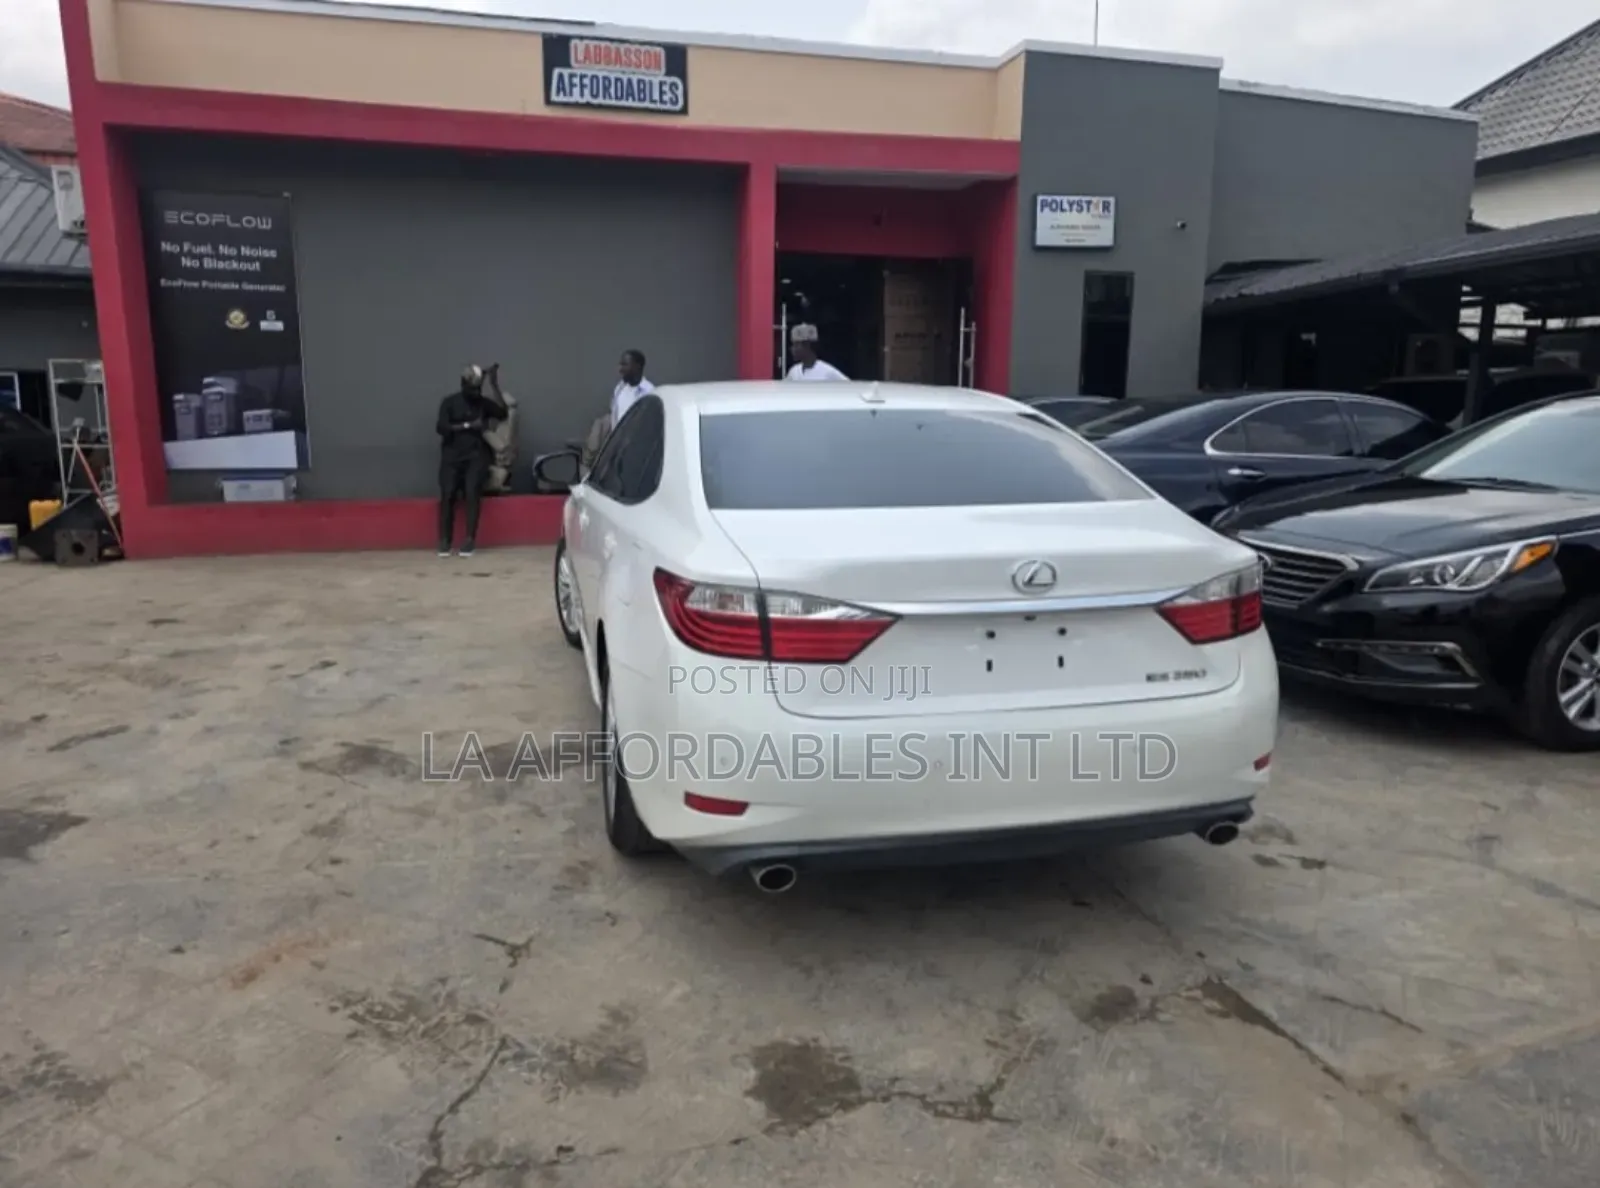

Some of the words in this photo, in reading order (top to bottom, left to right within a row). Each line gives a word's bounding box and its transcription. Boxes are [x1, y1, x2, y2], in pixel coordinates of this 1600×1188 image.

[555, 71, 680, 107] AFFORDABLES
[164, 210, 272, 230] ECOFLOW
[160, 241, 180, 254] No
[218, 243, 238, 257] No
[240, 245, 278, 258] Noise
[181, 256, 201, 269] No
[202, 257, 261, 272] Blackout
